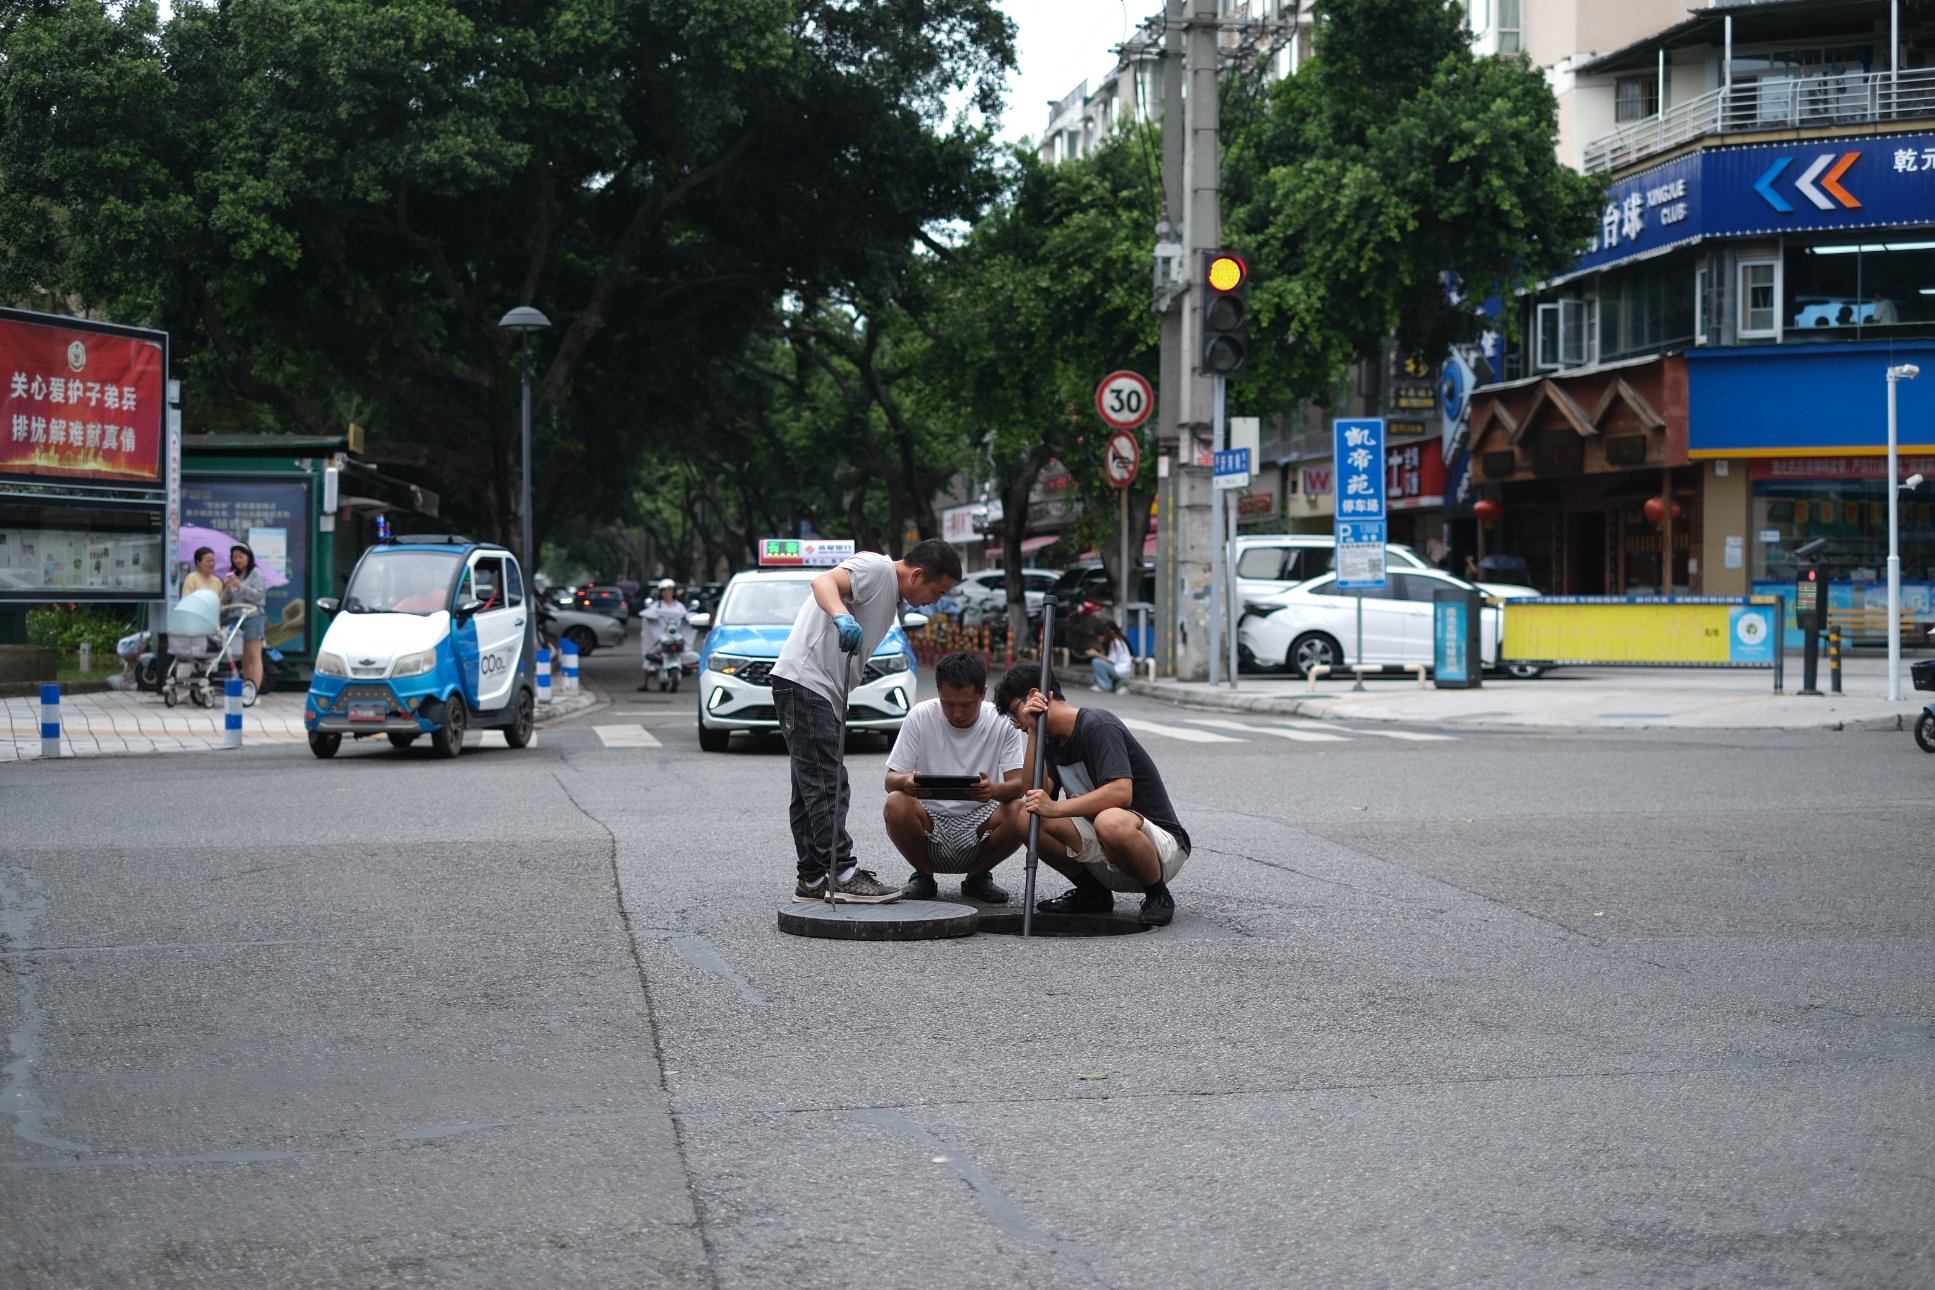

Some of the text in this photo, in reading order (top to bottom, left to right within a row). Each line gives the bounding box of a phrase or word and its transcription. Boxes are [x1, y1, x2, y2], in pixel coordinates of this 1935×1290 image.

[1893, 148, 1935, 173] 乾元
[1588, 191, 1644, 253] 台球
[1661, 203, 1687, 225] CLUB
[11, 372, 137, 411] 关心爱护子弟兵
[1110, 389, 1141, 413] 30
[12, 414, 136, 453] 排忧解难献真情
